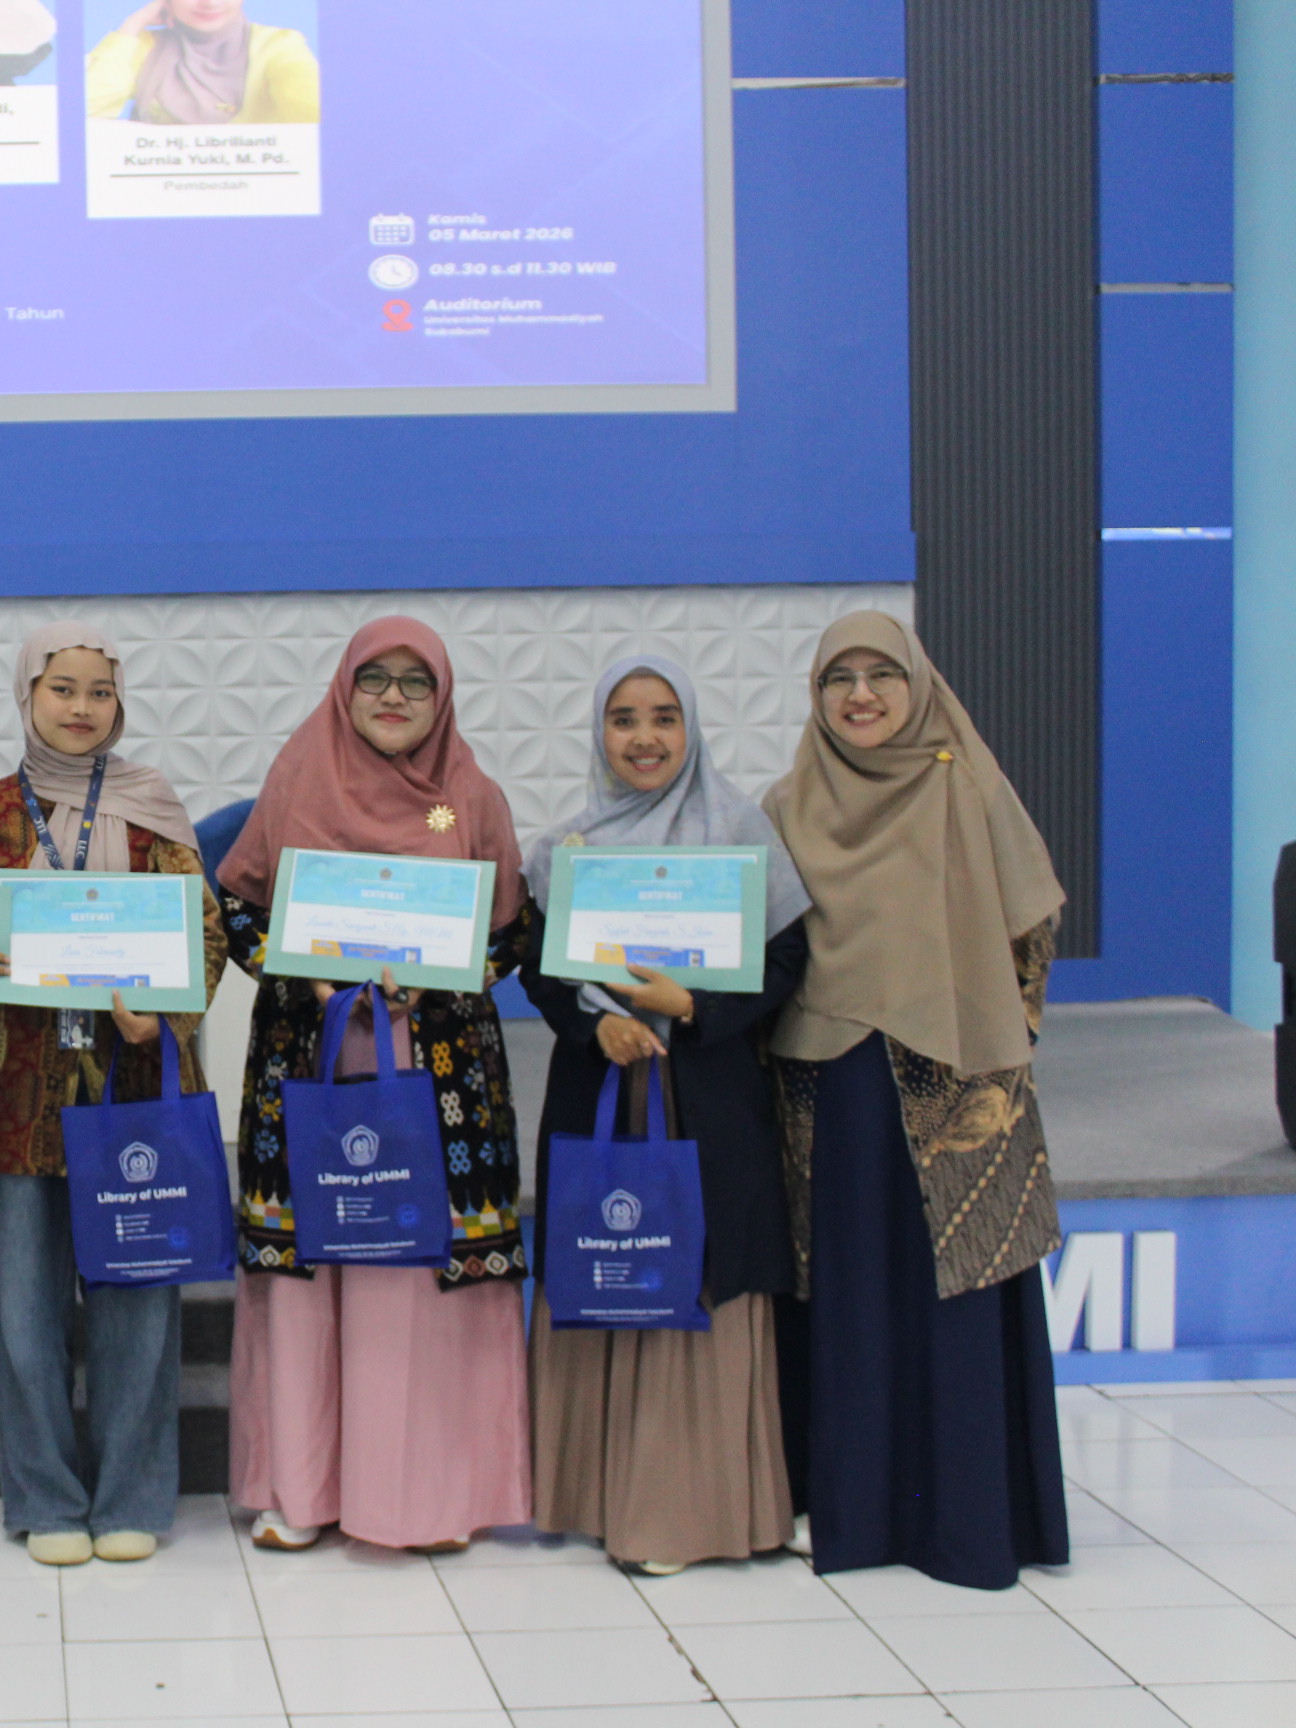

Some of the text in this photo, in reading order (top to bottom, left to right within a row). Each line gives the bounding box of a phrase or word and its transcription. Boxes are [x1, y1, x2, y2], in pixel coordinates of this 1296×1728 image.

[136, 135, 161, 150] Dr.
[166, 135, 189, 153] Hj.
[123, 151, 291, 169] Kurnia Yuki, M. Pd.
[163, 178, 249, 192] Pembedah
[428, 213, 487, 226] Kamis
[429, 227, 574, 242] 05 Maret 2026
[577, 261, 617, 274] WIB
[424, 297, 543, 312] Auditorium
[6, 306, 65, 321] Tahun
[317, 1168, 410, 1187] Library of UMMI
[97, 1186, 188, 1204] Library of UMMI
[577, 1236, 619, 1252] Library
[619, 1237, 634, 1250] of
